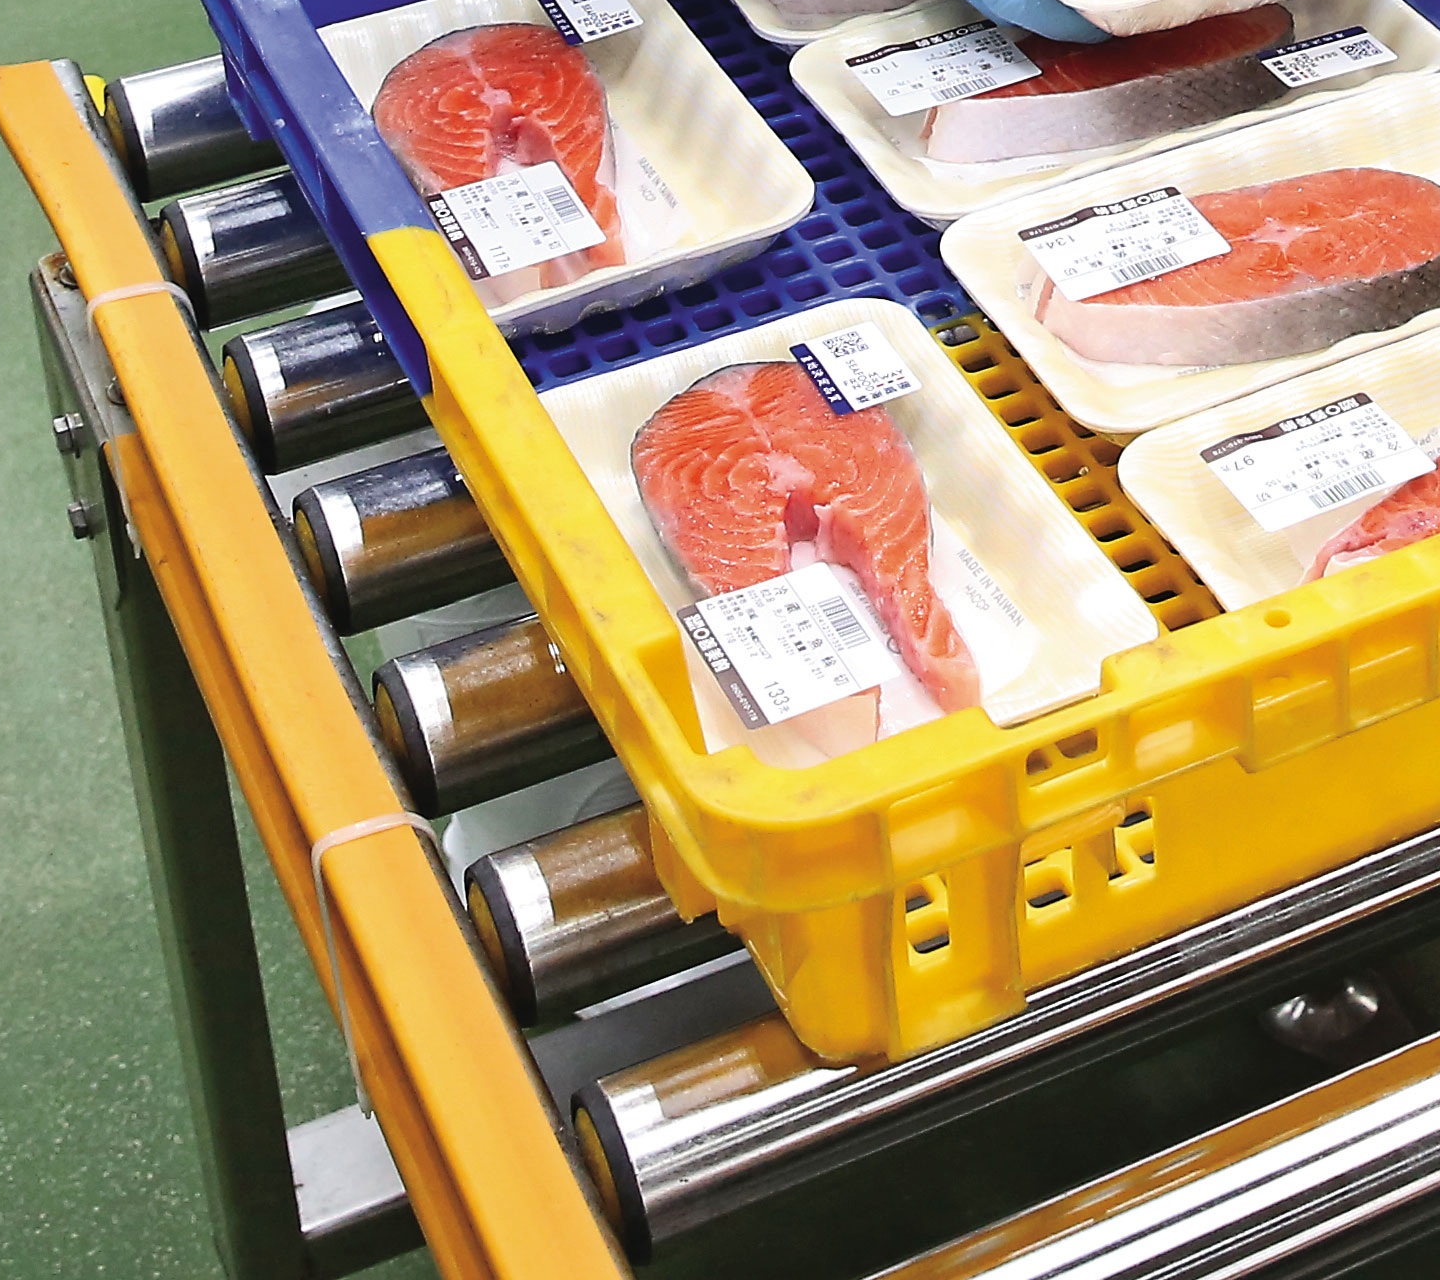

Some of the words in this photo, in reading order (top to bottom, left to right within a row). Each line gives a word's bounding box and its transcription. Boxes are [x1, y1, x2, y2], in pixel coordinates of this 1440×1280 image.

[956, 548, 985, 577] MADE
[979, 571, 994, 590] IN
[990, 583, 1025, 627] TAIWAN
